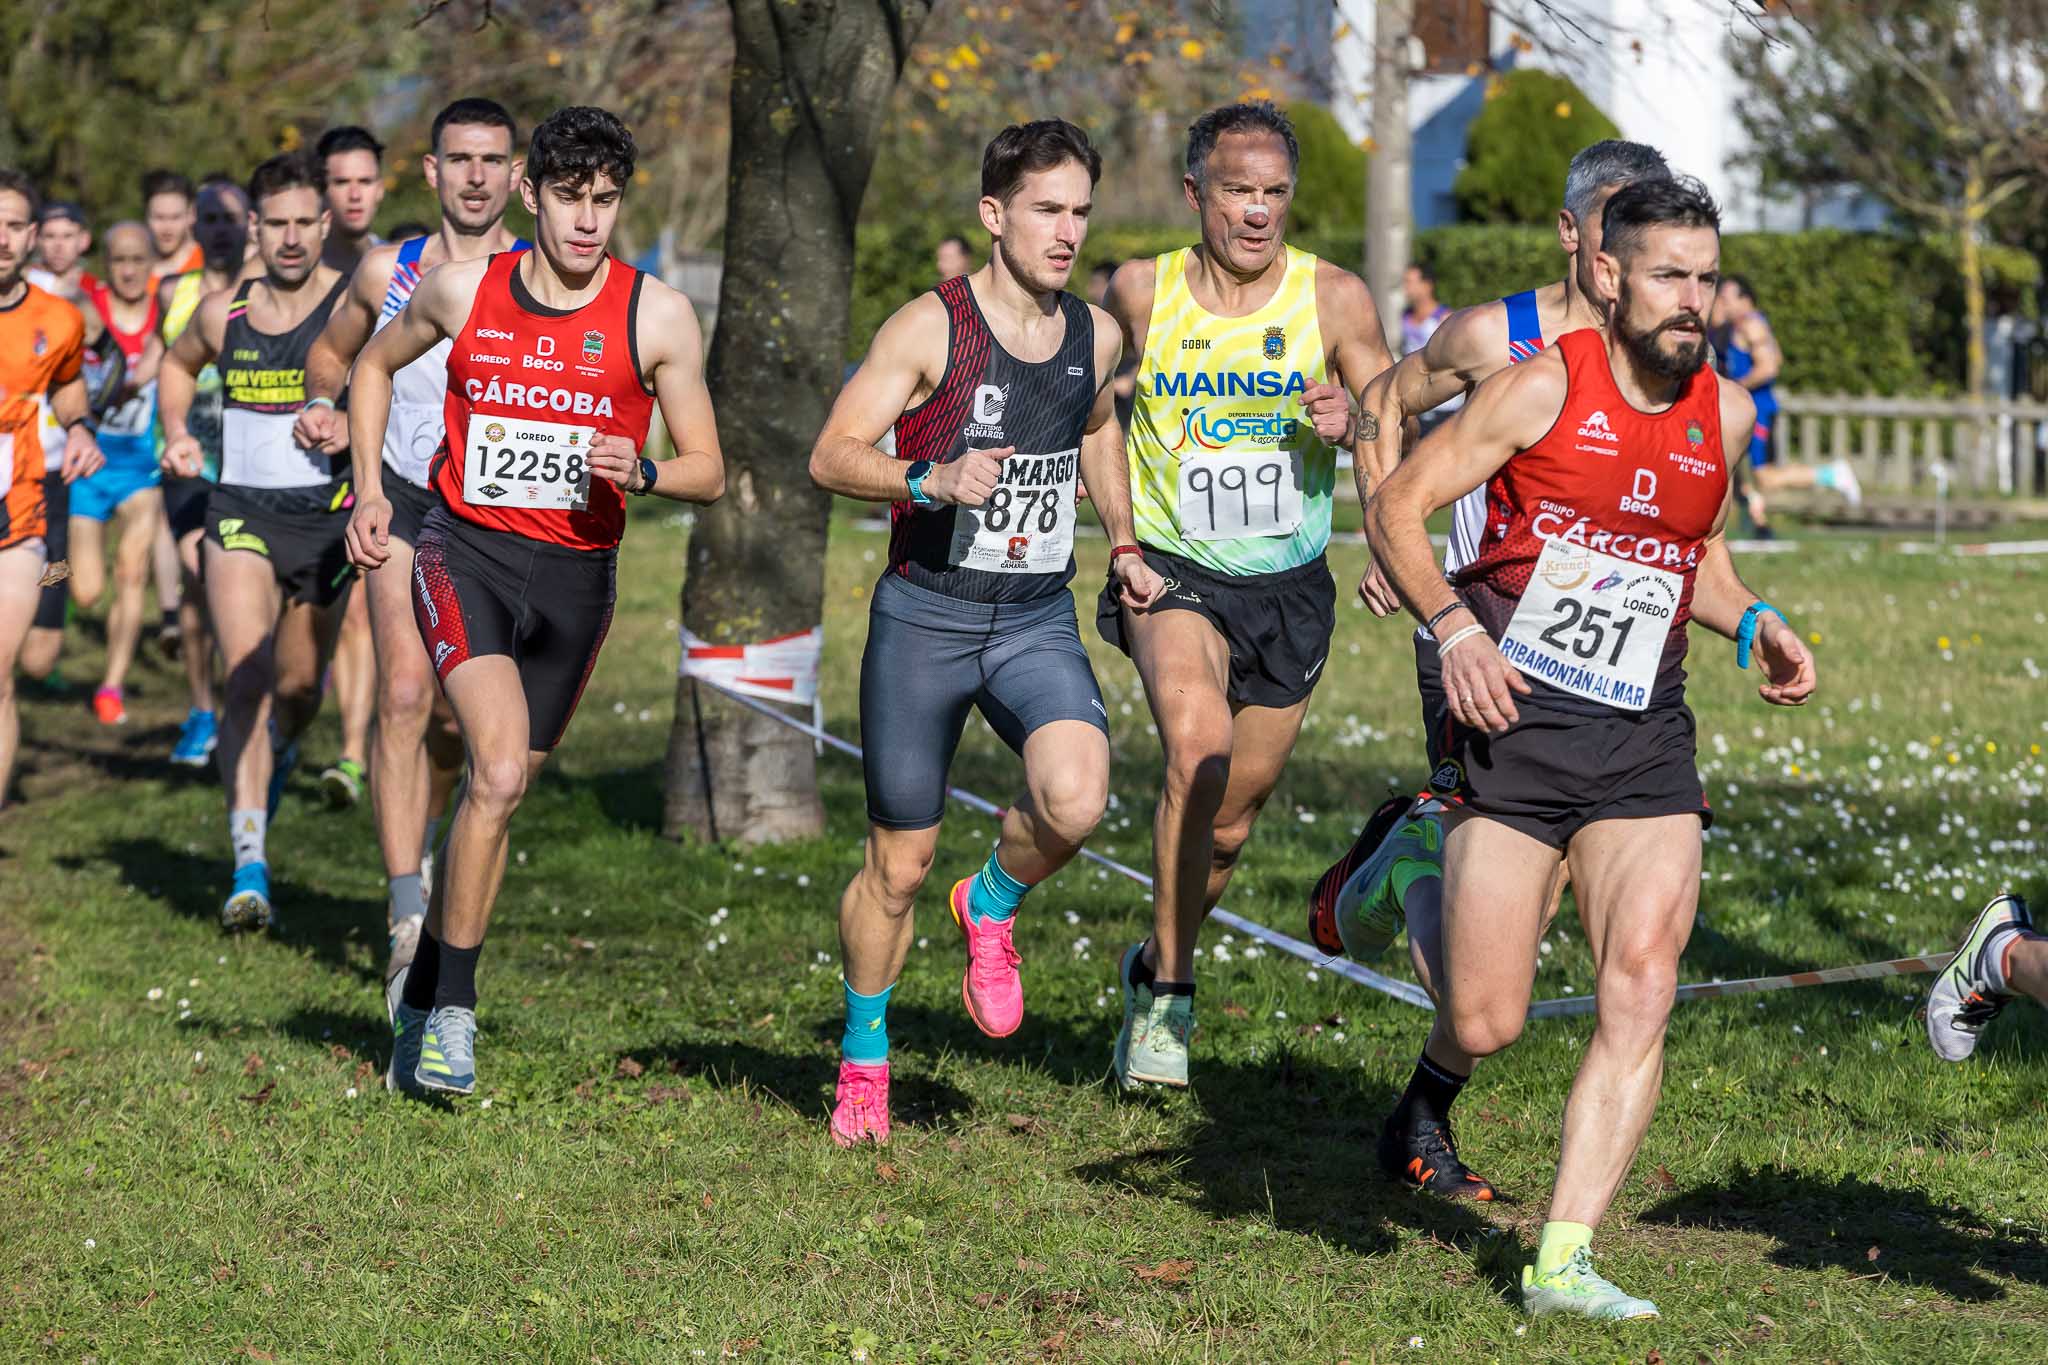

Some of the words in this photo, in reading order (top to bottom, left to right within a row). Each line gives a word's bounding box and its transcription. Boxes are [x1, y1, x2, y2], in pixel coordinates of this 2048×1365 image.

[1182, 339, 1211, 350] GOBIK
[470, 353, 511, 366] LOREDO
[522, 354, 565, 372] Beco
[1155, 371, 1305, 396] MAINSA
[465, 375, 614, 418] CÁRCOBA
[516, 432, 555, 443] LOREDO
[963, 427, 1005, 440] CAMARGO
[969, 423, 1002, 432] ATLETISMO
[477, 445, 584, 485] 12258
[1188, 463, 1283, 531] 999
[1539, 500, 1576, 517] GRUPO
[1619, 495, 1660, 518] Beco
[984, 487, 1060, 534] 878
[1546, 558, 1591, 572] Krunch
[1626, 575, 1650, 590] JUNTA
[1654, 575, 1677, 603] VECINAL
[1623, 596, 1669, 619] LOREDO
[1539, 597, 1636, 667] 251
[1501, 636, 1595, 693] RIBAMONTÁN
[1595, 675, 1609, 698] AL
[1613, 679, 1645, 707] MAR
